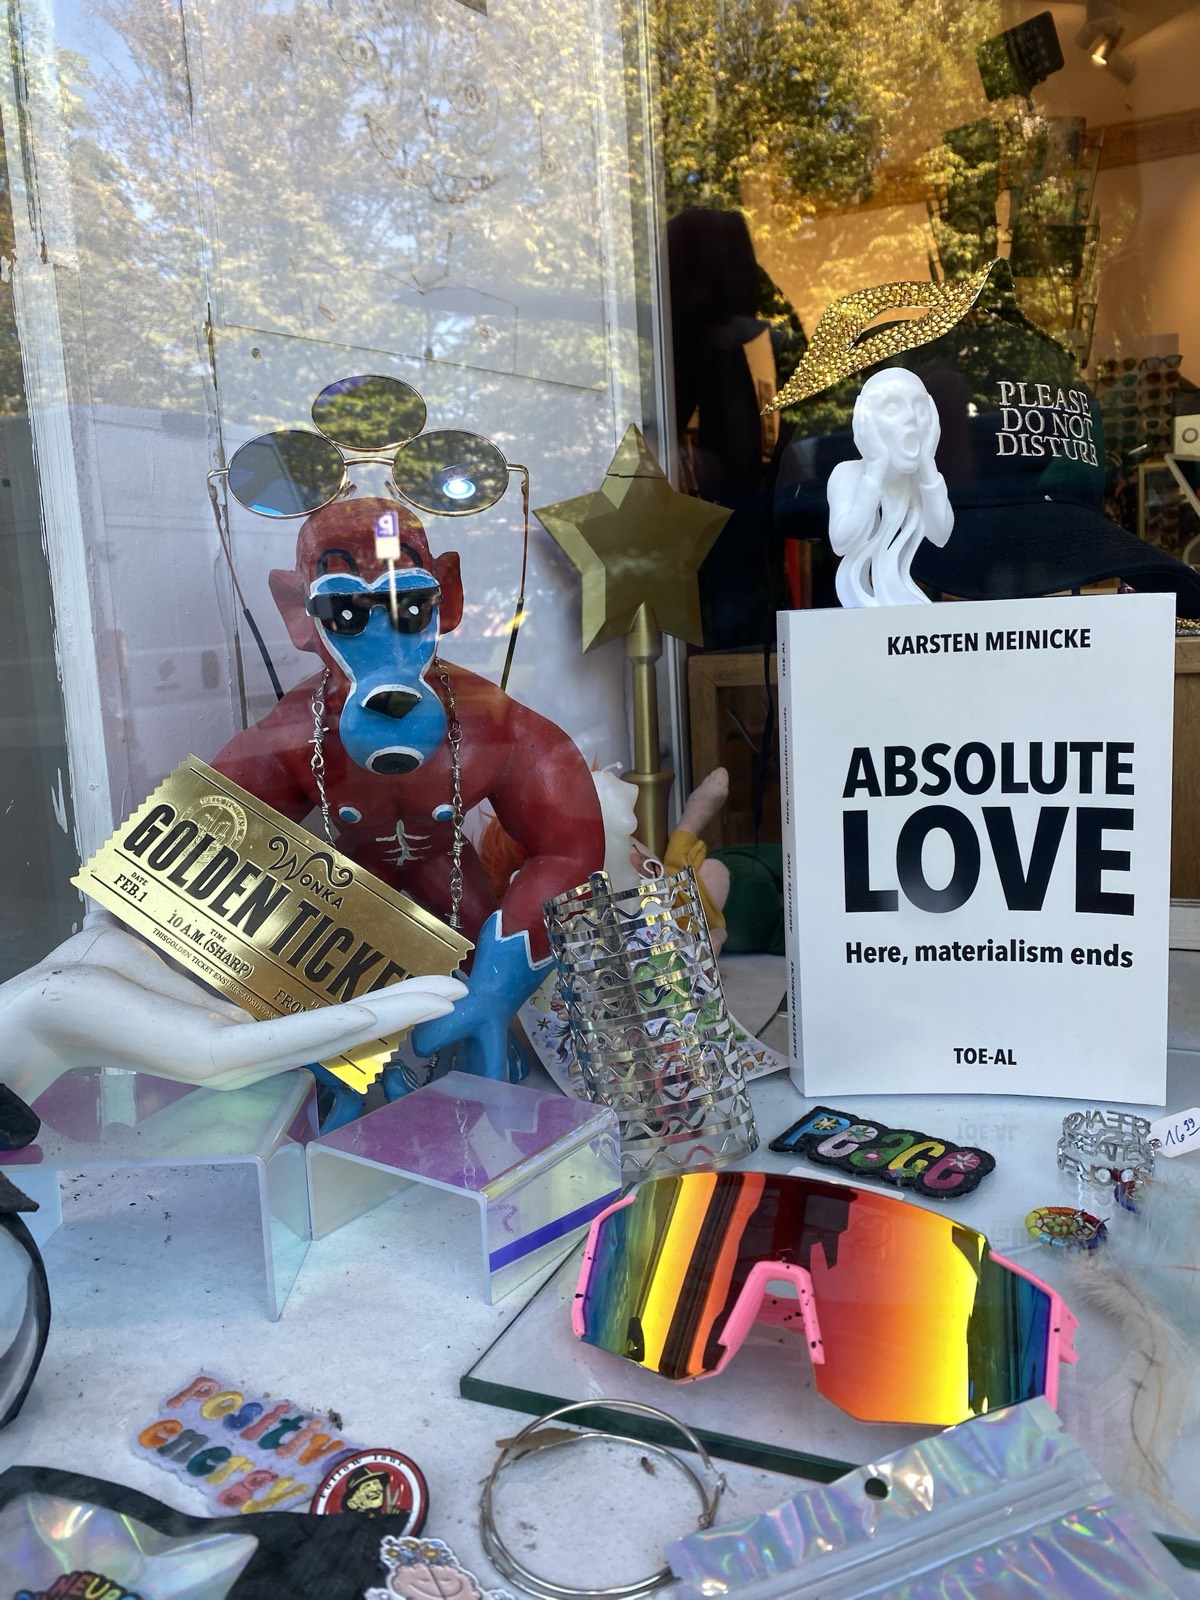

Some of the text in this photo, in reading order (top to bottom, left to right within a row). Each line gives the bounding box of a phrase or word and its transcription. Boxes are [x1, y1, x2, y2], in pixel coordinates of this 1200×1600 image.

[996, 381, 1092, 418] PLEASE
[1000, 407, 1093, 442] DO NOT
[995, 432, 1098, 467] DISTURB
[887, 628, 1091, 656] KARSTEN MEINICKE
[842, 741, 1135, 798] ABSOLUTE
[842, 804, 1135, 916] LOVE
[131, 872, 149, 886] DATE
[123, 803, 416, 1003] GOLDEN TICKE
[167, 912, 255, 979] 10 A.M. (SHARP)
[210, 928, 227, 943] TIME
[191, 956, 215, 975] TICKET
[846, 939, 1134, 968] Here, materialism ends
[953, 1047, 1018, 1066] TOE-AL
